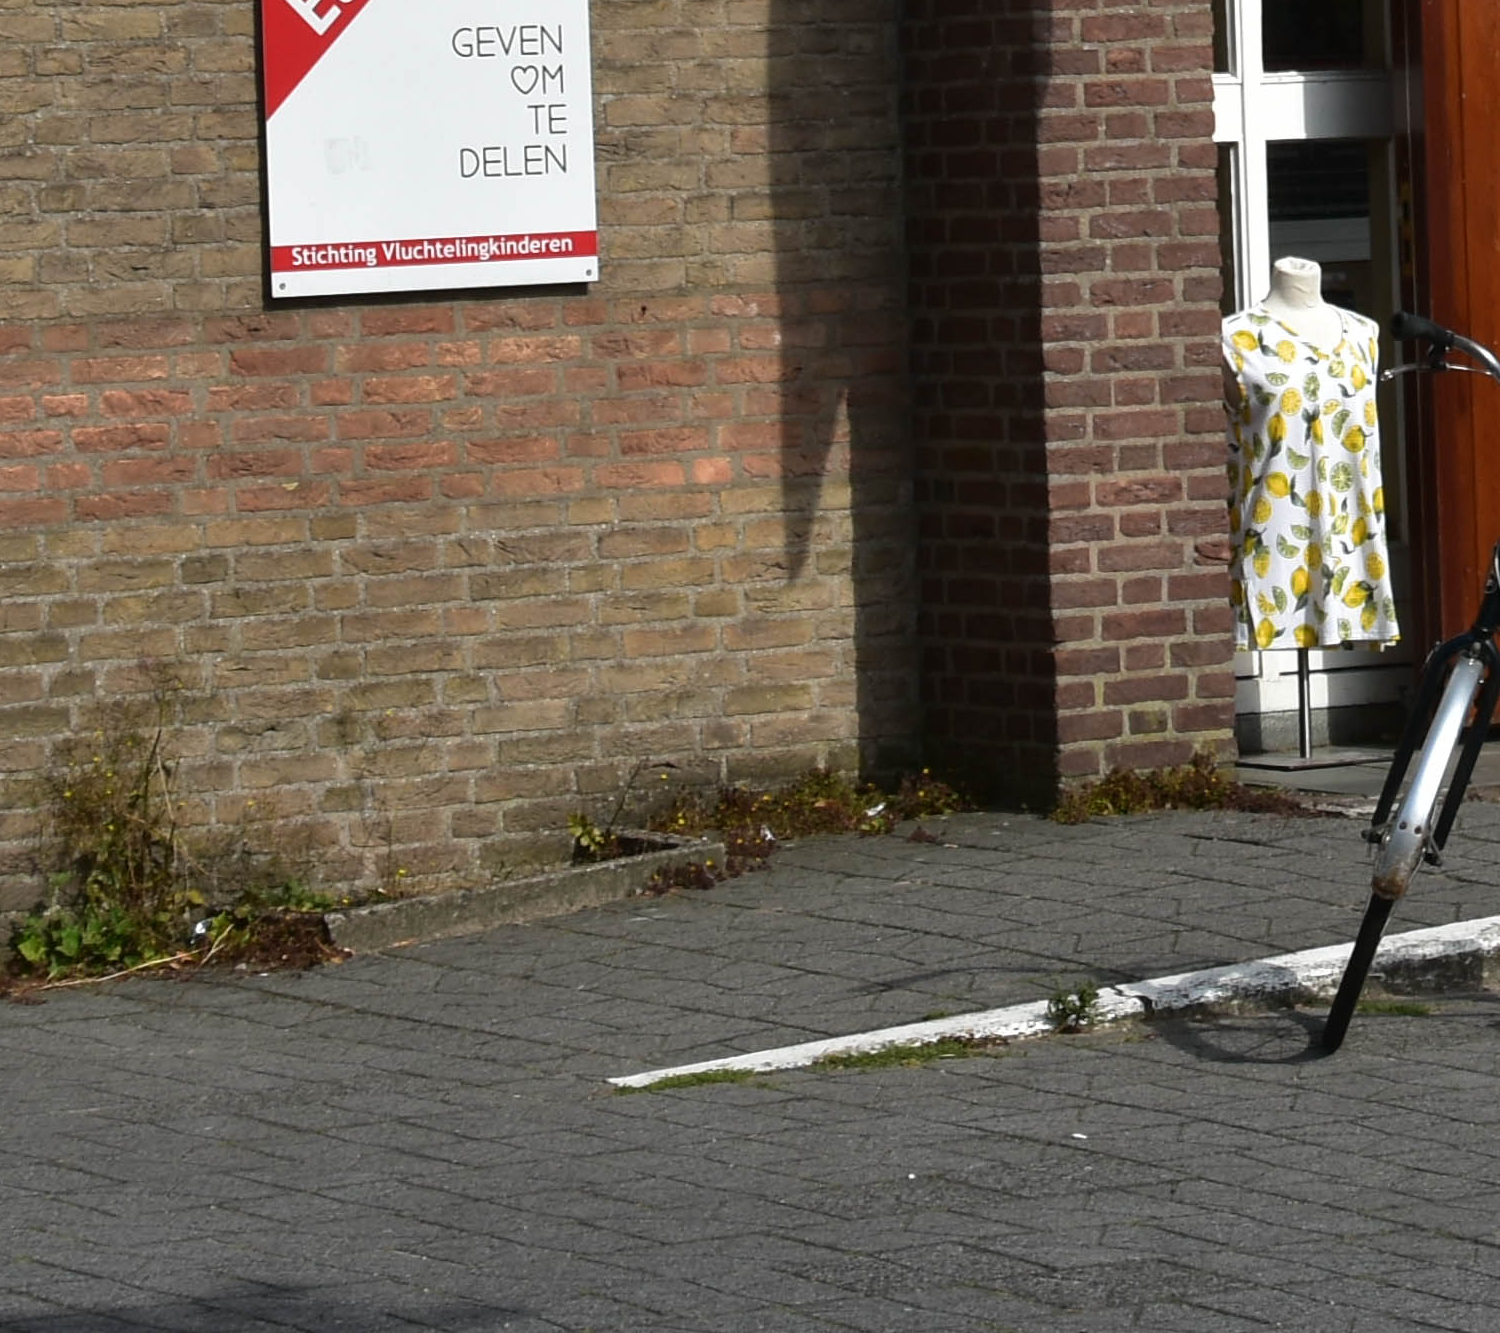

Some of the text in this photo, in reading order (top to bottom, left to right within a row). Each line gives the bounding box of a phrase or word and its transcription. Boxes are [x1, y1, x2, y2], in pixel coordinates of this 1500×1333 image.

[451, 24, 564, 59] GEVEN
[527, 104, 568, 135] TE
[460, 144, 568, 179] DELEN
[291, 234, 574, 267] Stichting Vluchtelingkinderen
